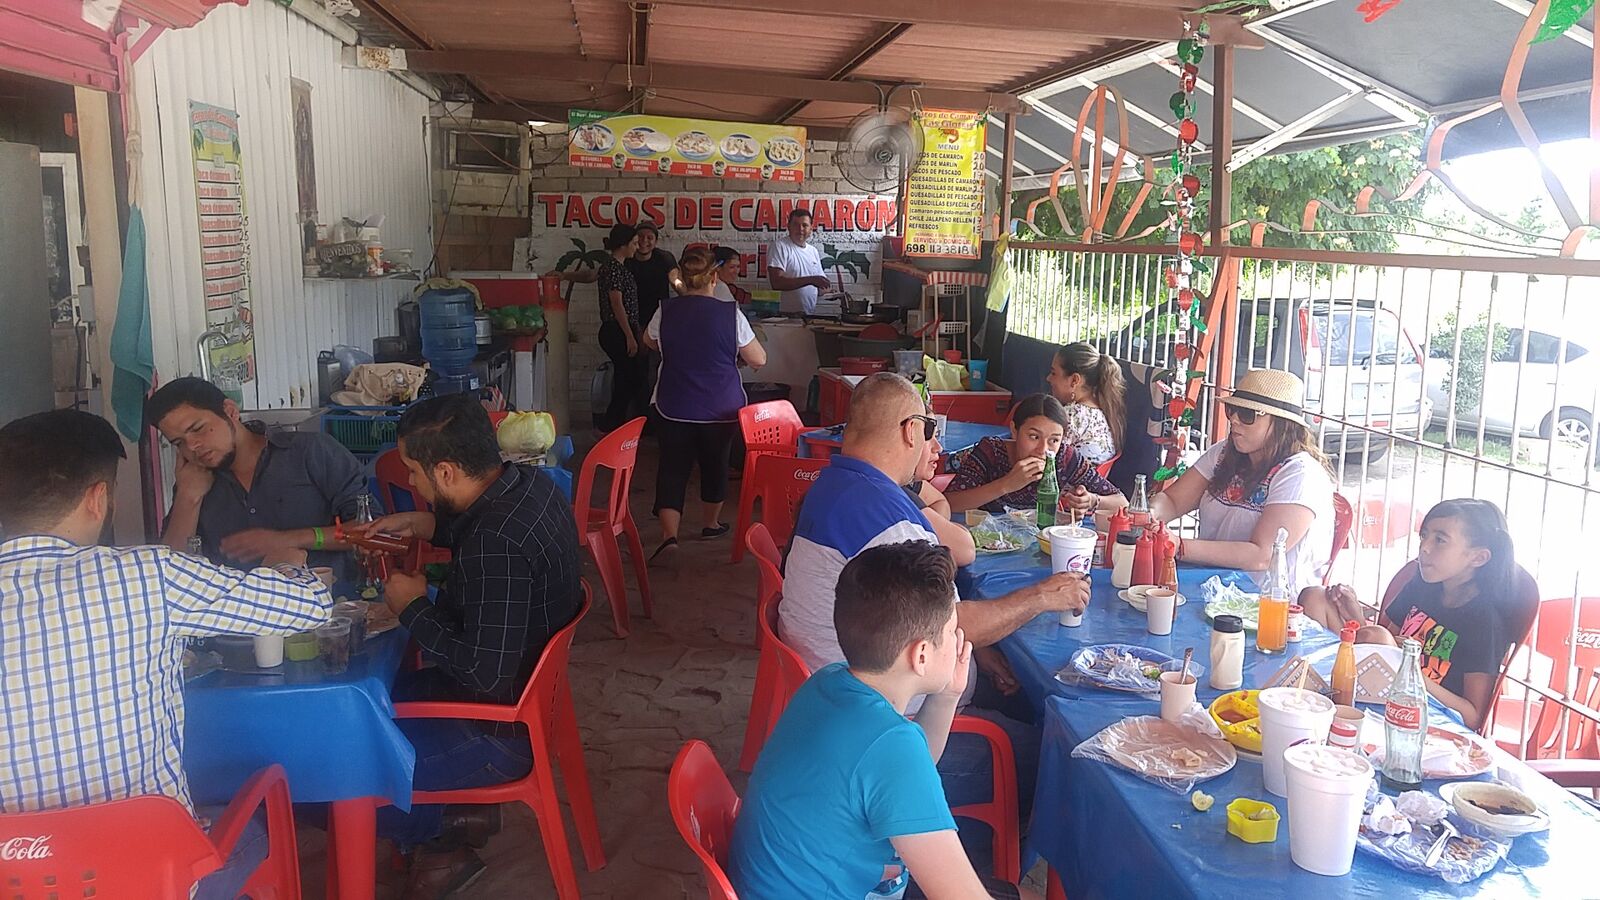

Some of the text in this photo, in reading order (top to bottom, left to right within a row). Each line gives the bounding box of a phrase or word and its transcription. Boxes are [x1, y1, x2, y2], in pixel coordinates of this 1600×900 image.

[537, 194, 667, 230] TACOS
[673, 196, 724, 230] DE
[906, 243, 926, 253] 698
